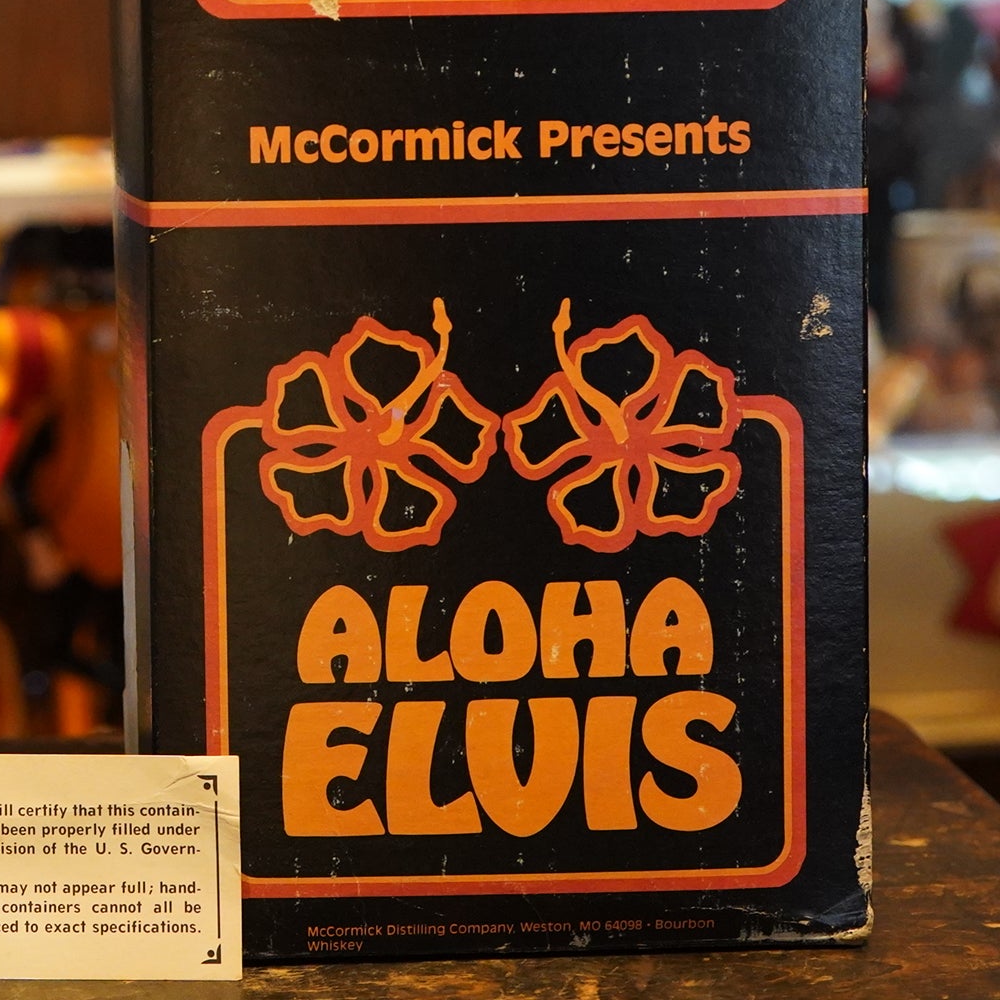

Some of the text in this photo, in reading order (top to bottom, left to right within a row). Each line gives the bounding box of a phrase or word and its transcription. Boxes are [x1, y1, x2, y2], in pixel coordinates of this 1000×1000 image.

[249, 114, 751, 164] McCormick Presents
[296, 576, 715, 684] ALOHA
[281, 690, 743, 838] ELVIS
[17, 803, 68, 819] certify
[72, 804, 103, 817] that
[107, 803, 135, 817] this
[139, 803, 201, 817] contain-
[0, 823, 36, 836] been
[41, 823, 106, 838] properly
[111, 822, 150, 836] filled
[156, 822, 201, 836] under
[42, 842, 58, 855] of
[63, 842, 87, 855] the
[95, 842, 111, 855] U.
[119, 842, 133, 855] S.
[140, 842, 201, 855] Govern-
[33, 881, 57, 894] not
[61, 883, 116, 896] appear
[120, 881, 154, 896] full;
[159, 881, 202, 894] hand-
[1, 900, 81, 914] containers
[91, 901, 142, 914] cannot
[153, 900, 173, 914] all
[183, 900, 202, 914] be
[24, 920, 39, 933] to
[44, 920, 86, 933] exact
[91, 920, 202, 936] specifications.
[307, 925, 383, 938] McCormick
[386, 923, 446, 938] Distilling
[579, 920, 601, 931] MO
[604, 919, 643, 931] 64098
[655, 918, 716, 930] Bourbon
[307, 940, 364, 952] Whiskey
